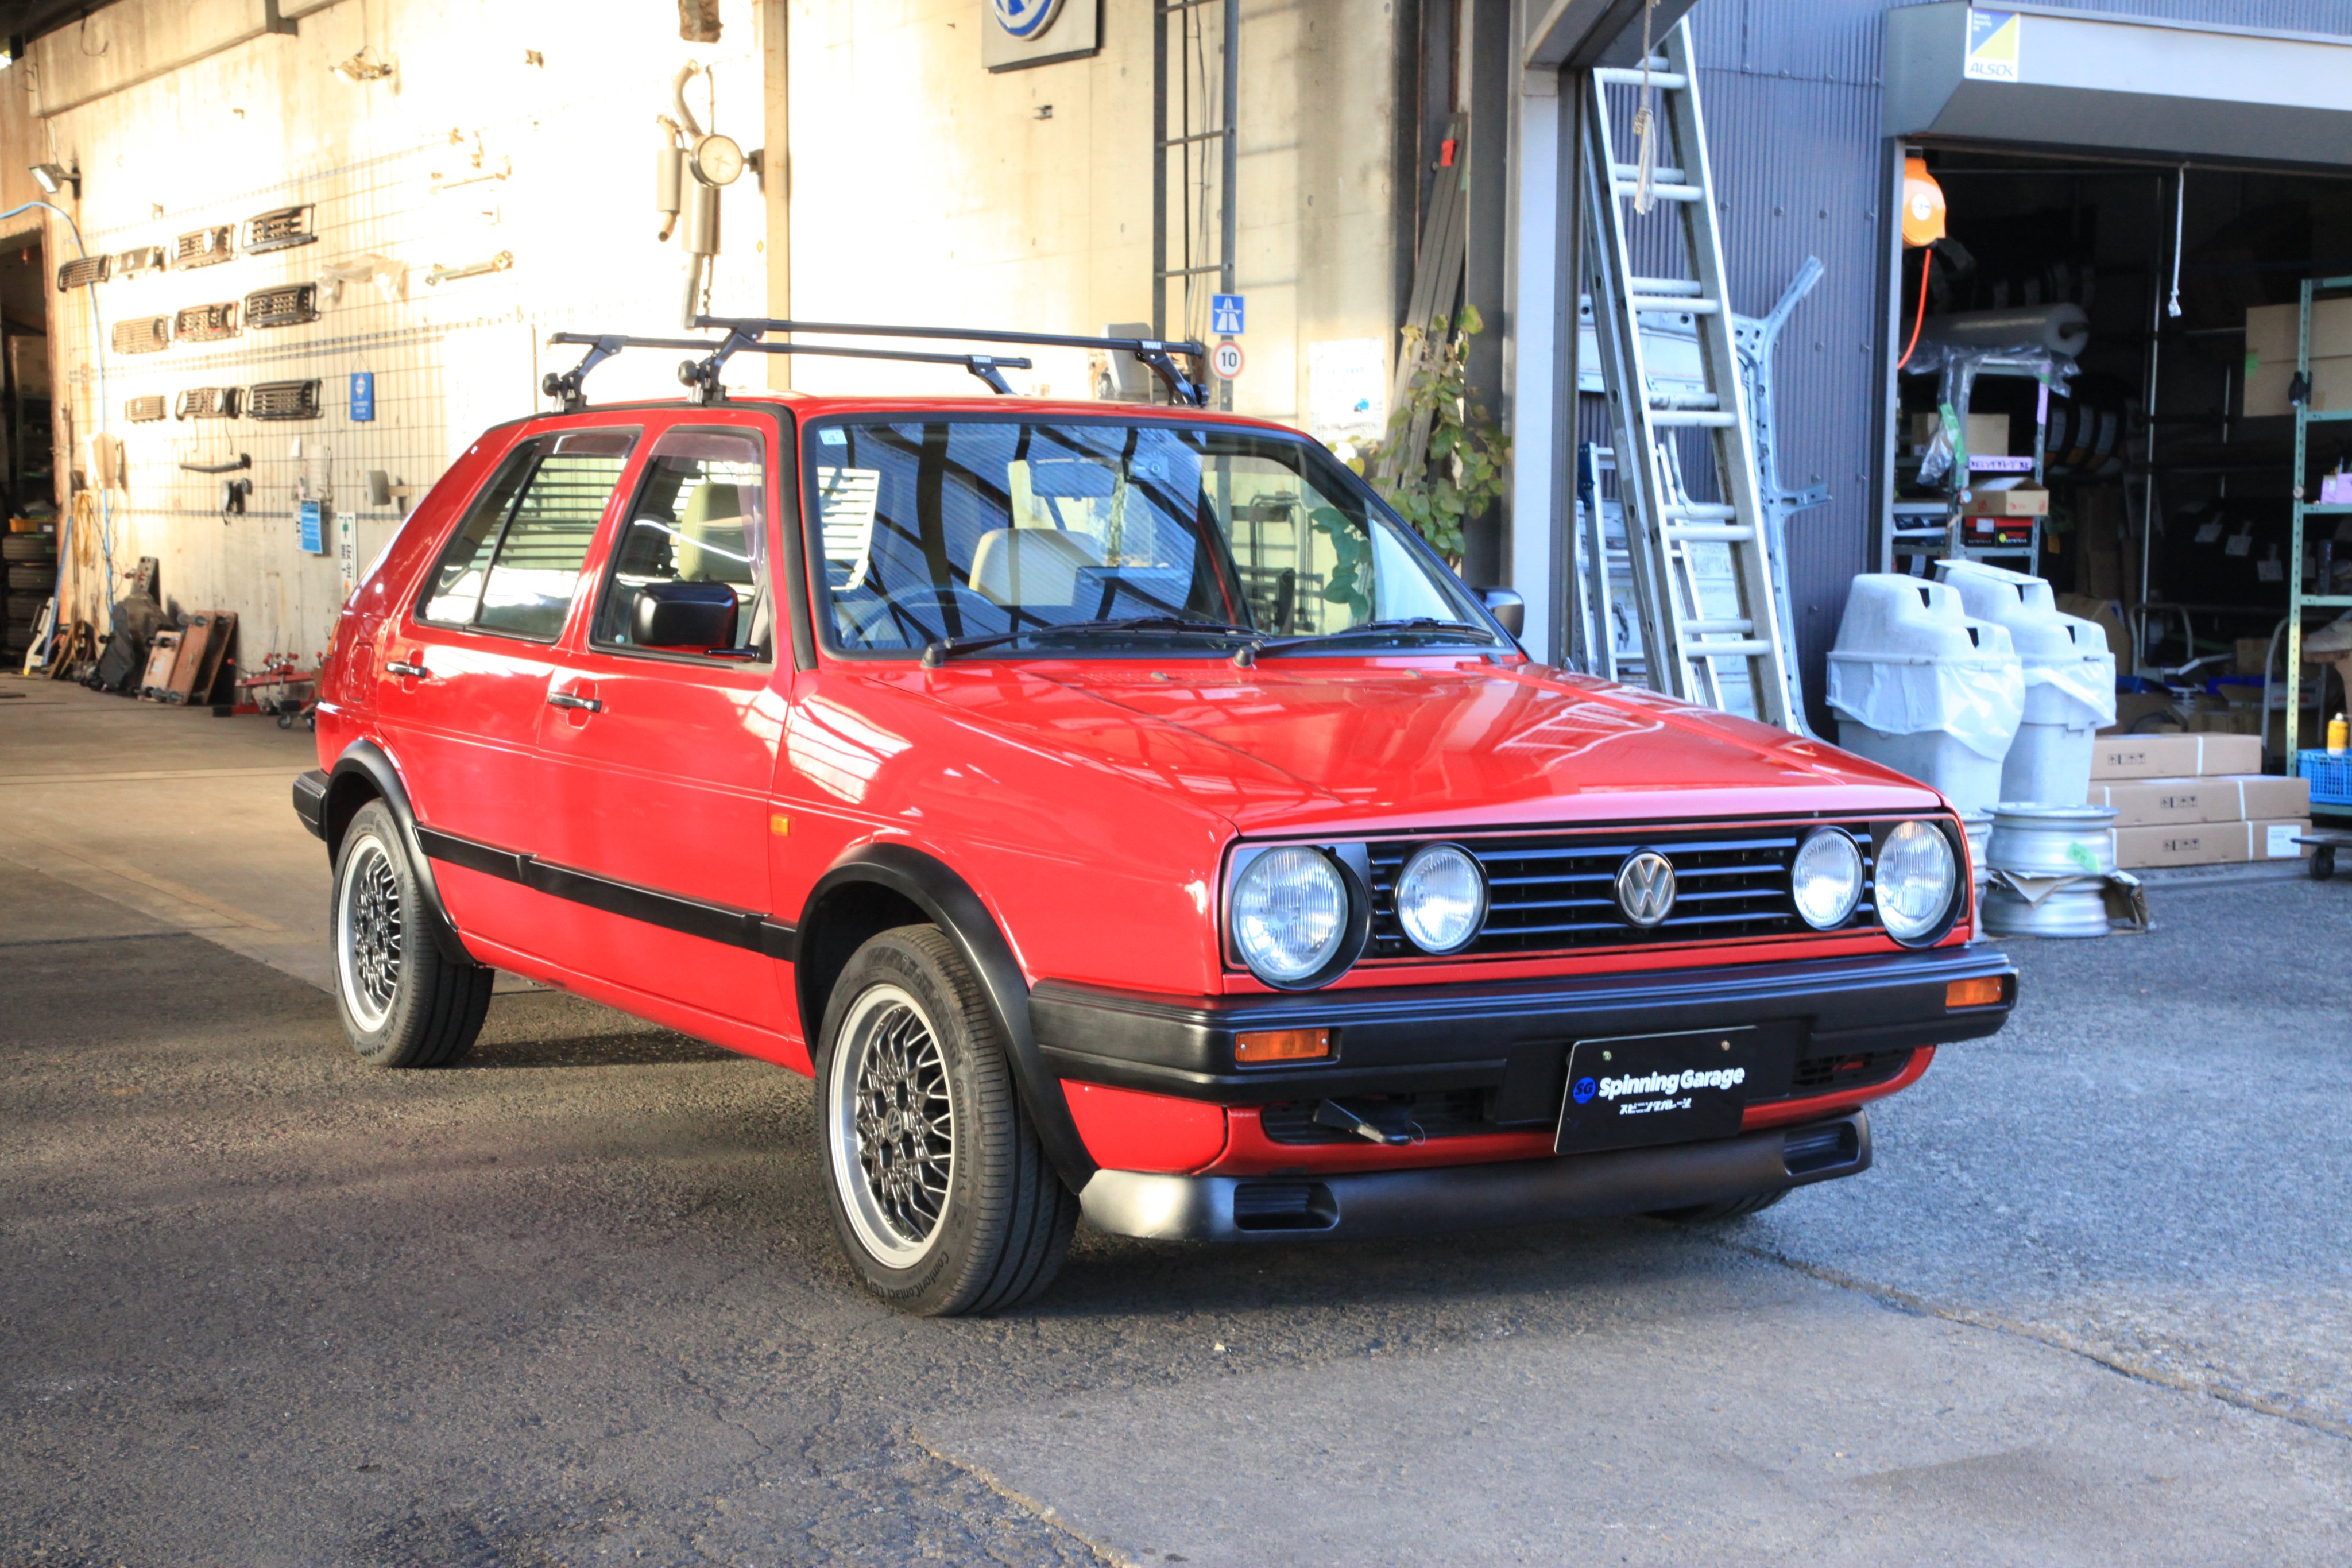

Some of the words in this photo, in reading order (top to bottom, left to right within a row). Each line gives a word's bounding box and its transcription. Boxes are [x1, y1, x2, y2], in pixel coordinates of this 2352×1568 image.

[1970, 62, 2014, 76] ALSOK
[1221, 352, 1237, 367] 10
[1599, 1071, 1680, 1100] Spinning
[1680, 1068, 1745, 1090] Garage
